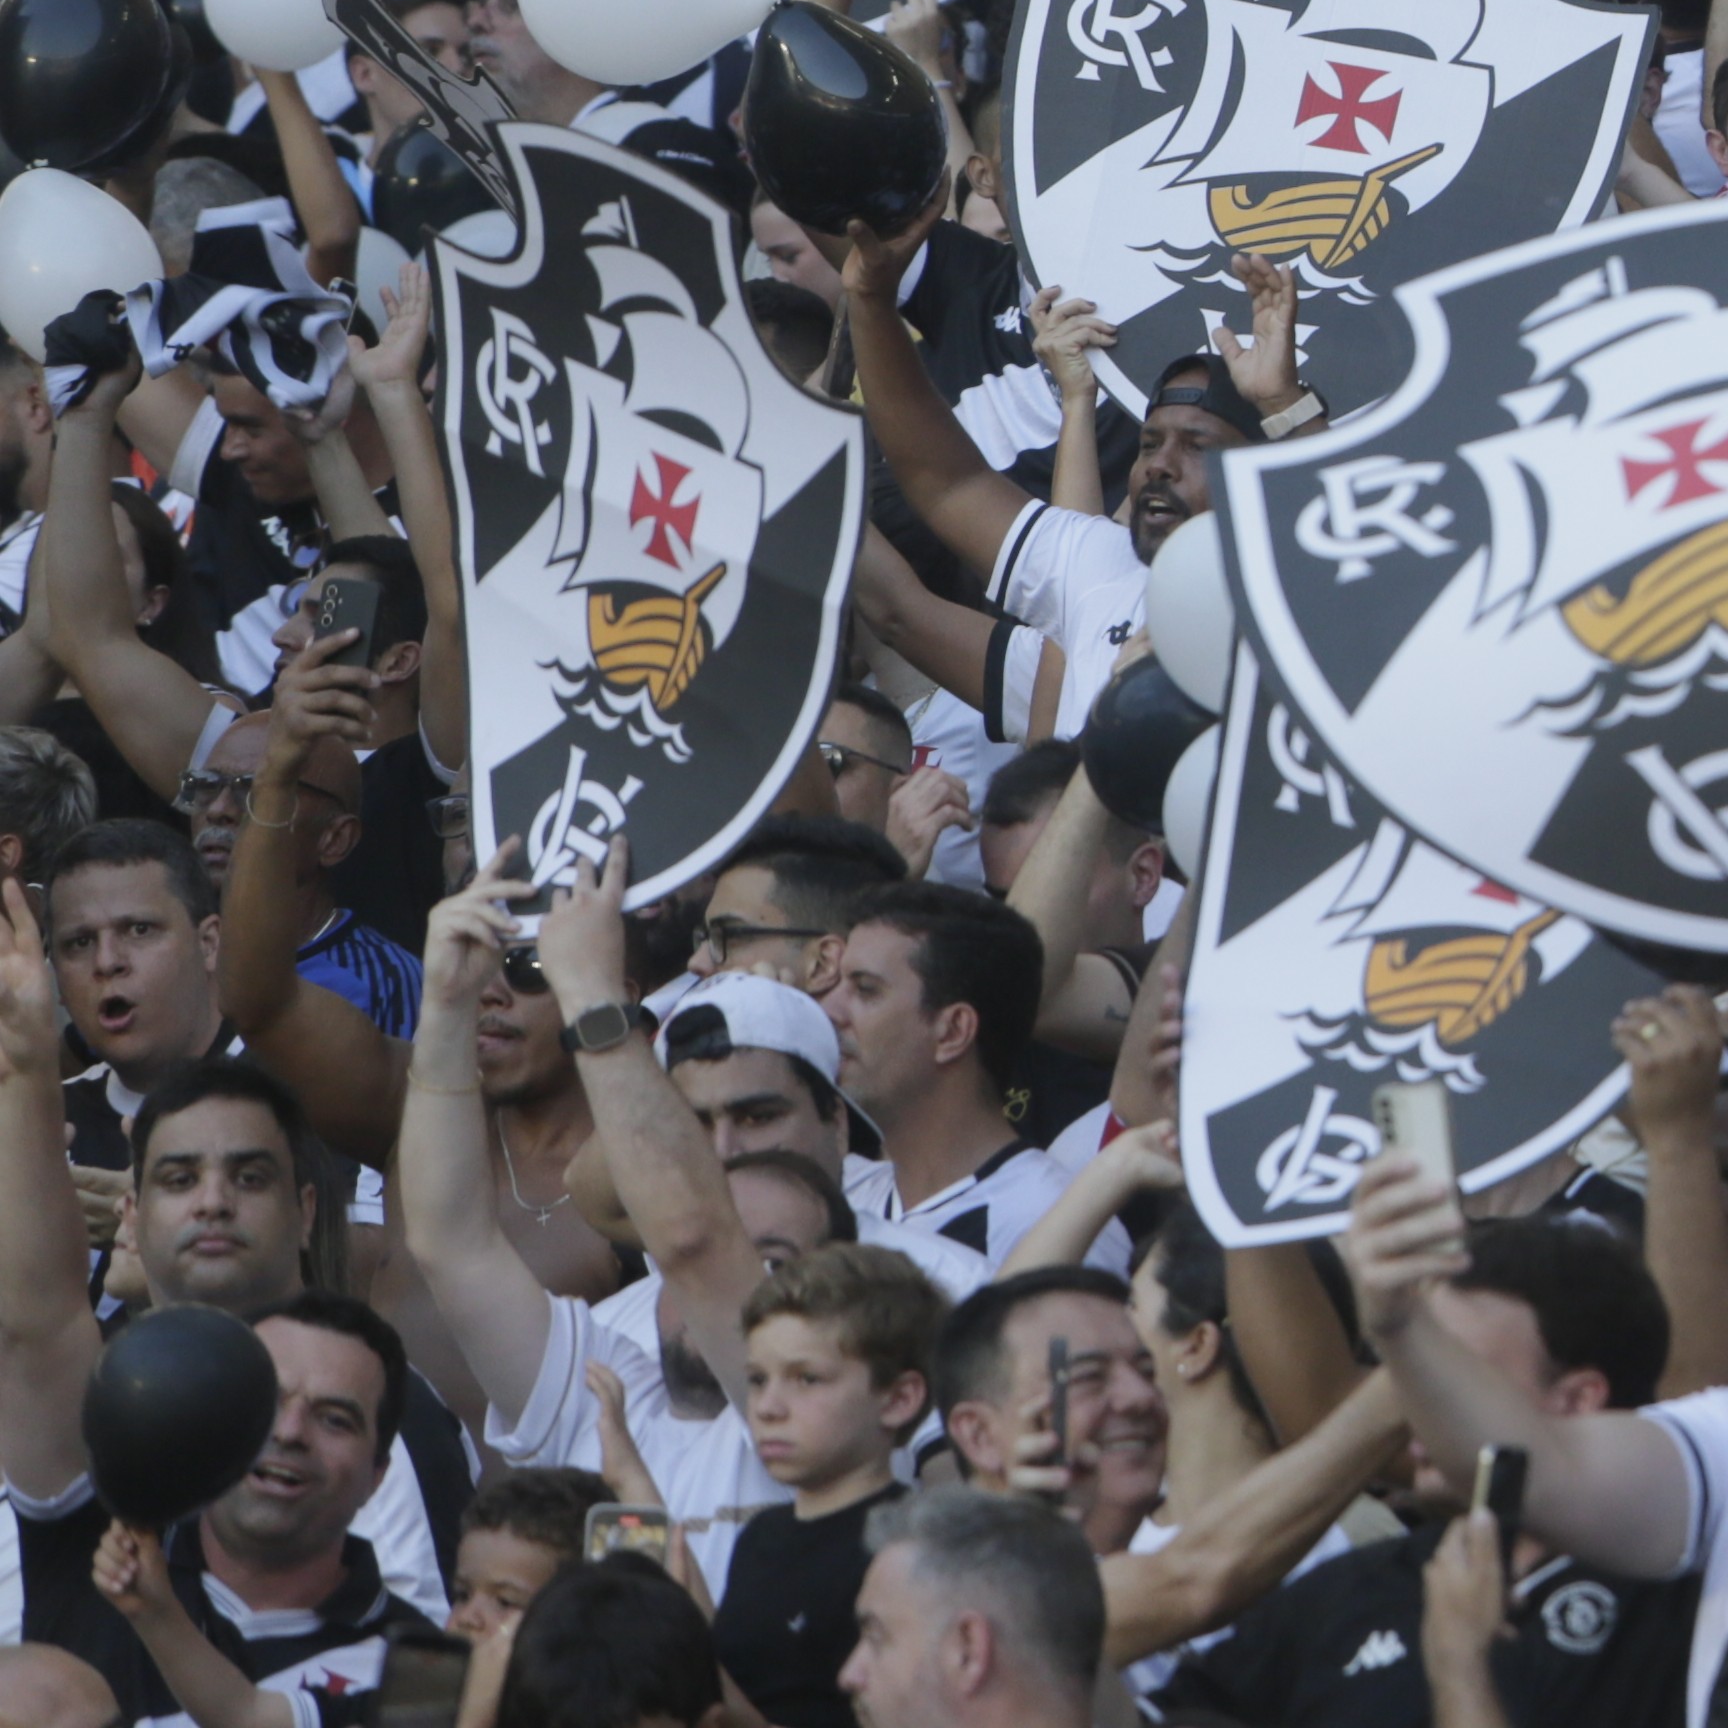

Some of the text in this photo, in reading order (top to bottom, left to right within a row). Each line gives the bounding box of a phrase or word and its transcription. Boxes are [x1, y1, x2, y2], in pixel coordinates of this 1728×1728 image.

[476, 305, 556, 477] CR
[1294, 454, 1458, 585] CR
[528, 744, 646, 894] VG
